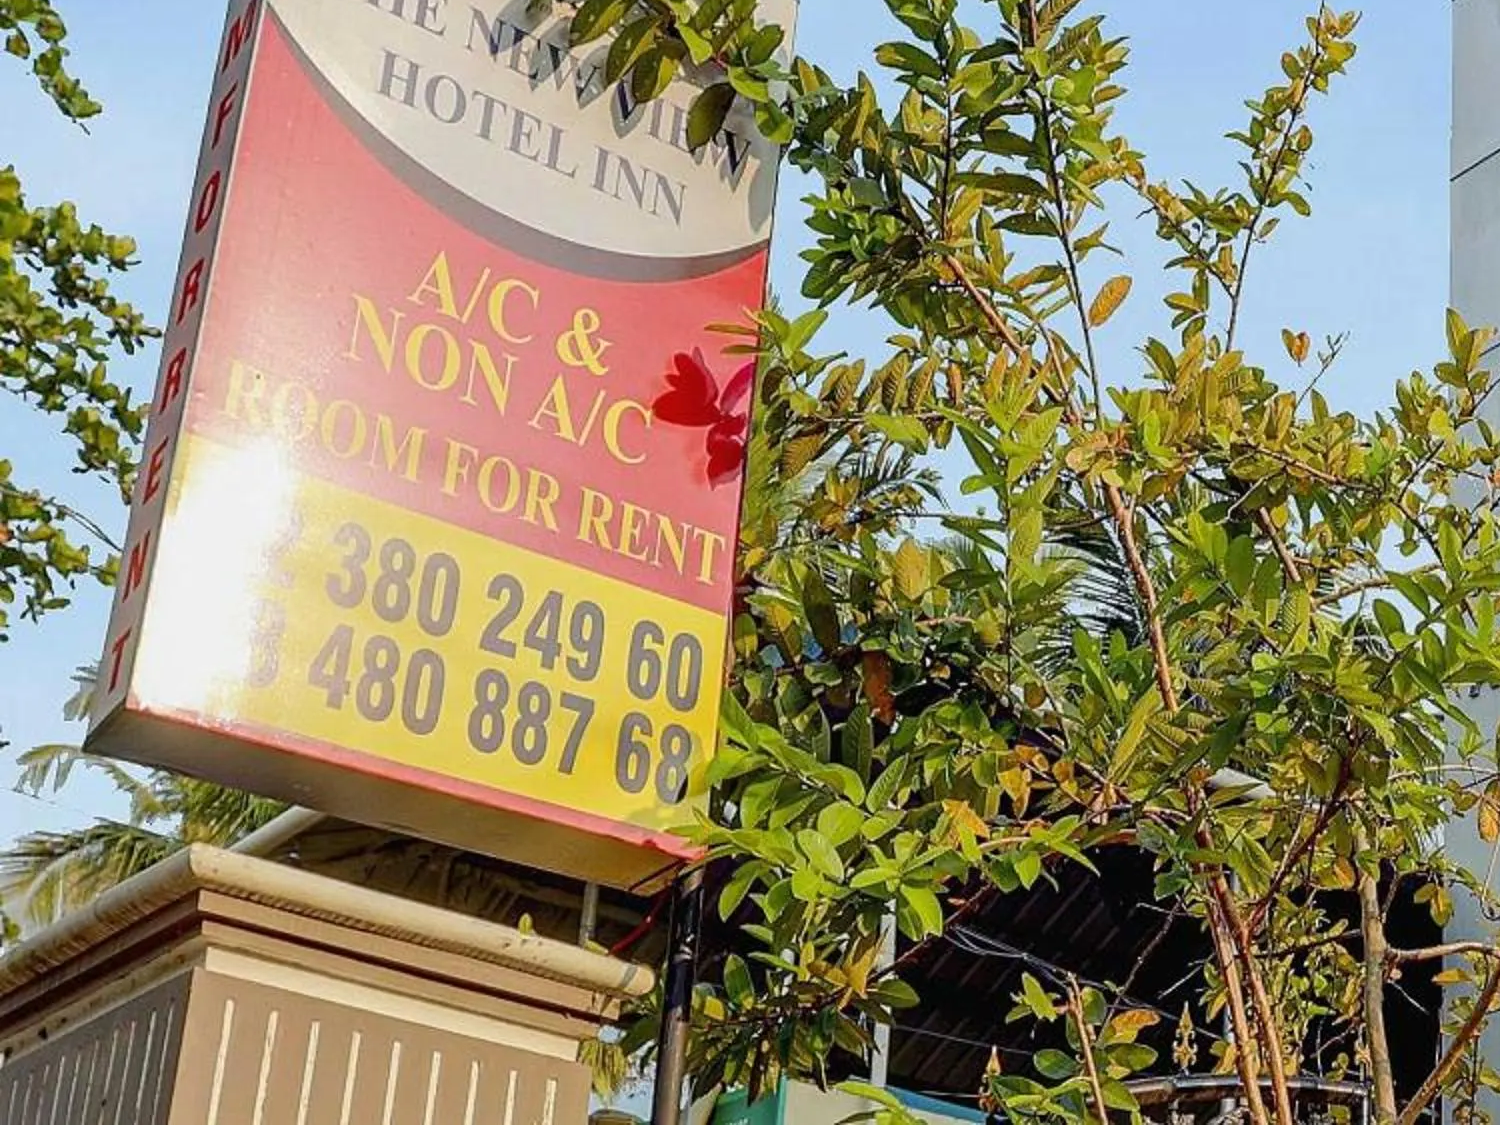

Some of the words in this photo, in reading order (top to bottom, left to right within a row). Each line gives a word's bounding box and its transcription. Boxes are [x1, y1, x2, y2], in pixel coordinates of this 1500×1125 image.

[377, 48, 579, 180] HOTEL
[591, 143, 688, 230] INN
[465, 5, 601, 103] NEW
[342, 292, 520, 418] NON
[527, 371, 654, 465] A/C
[407, 249, 541, 344] A/C
[555, 307, 613, 376] &
[217, 356, 430, 484] ROOM
[440, 437, 561, 534] FOR
[575, 485, 726, 587] RENT
[325, 520, 461, 638] 380
[478, 572, 606, 682] 249
[626, 619, 703, 712] 60
[307, 622, 446, 736] 480
[467, 667, 596, 776] 887
[614, 711, 693, 806] 68
